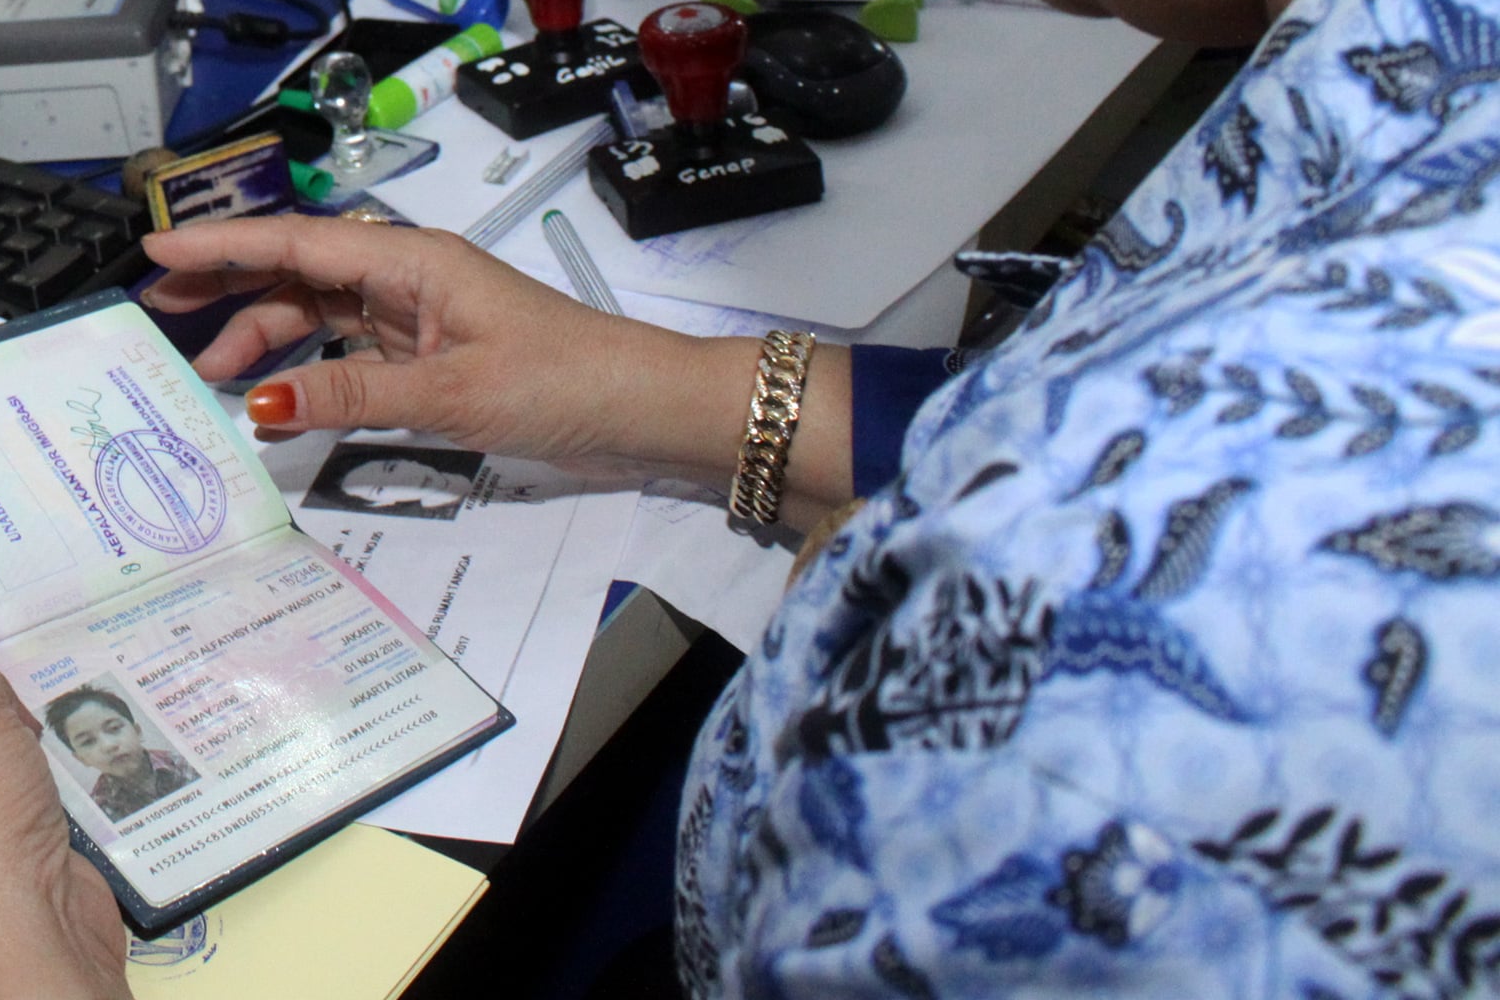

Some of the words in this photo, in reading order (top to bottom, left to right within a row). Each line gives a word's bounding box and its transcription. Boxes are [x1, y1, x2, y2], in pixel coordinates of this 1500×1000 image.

[7, 396, 52, 449] IMIGRASI
[48, 449, 91, 502] KANTOR
[88, 502, 126, 558] KEPALA
[136, 523, 180, 544] KANTOR
[143, 579, 207, 612] INDONESIA
[432, 591, 455, 623] RUMAH
[136, 650, 199, 688] MUHAMMAD
[250, 609, 287, 631] DAMAR
[288, 590, 325, 613] WASITO
[171, 624, 191, 637] IDN
[341, 620, 385, 647] JAKARTA
[30, 656, 75, 682] PASPOR
[344, 662, 359, 673] 01
[359, 650, 380, 667] NOV
[40, 667, 79, 691] PASSPORT
[155, 675, 214, 711] INDONESIA
[350, 680, 393, 709] JAKARTA
[390, 662, 428, 687] UTARA
[174, 720, 190, 734] 31
[189, 706, 213, 726] MAY
[207, 728, 233, 748] NOV
